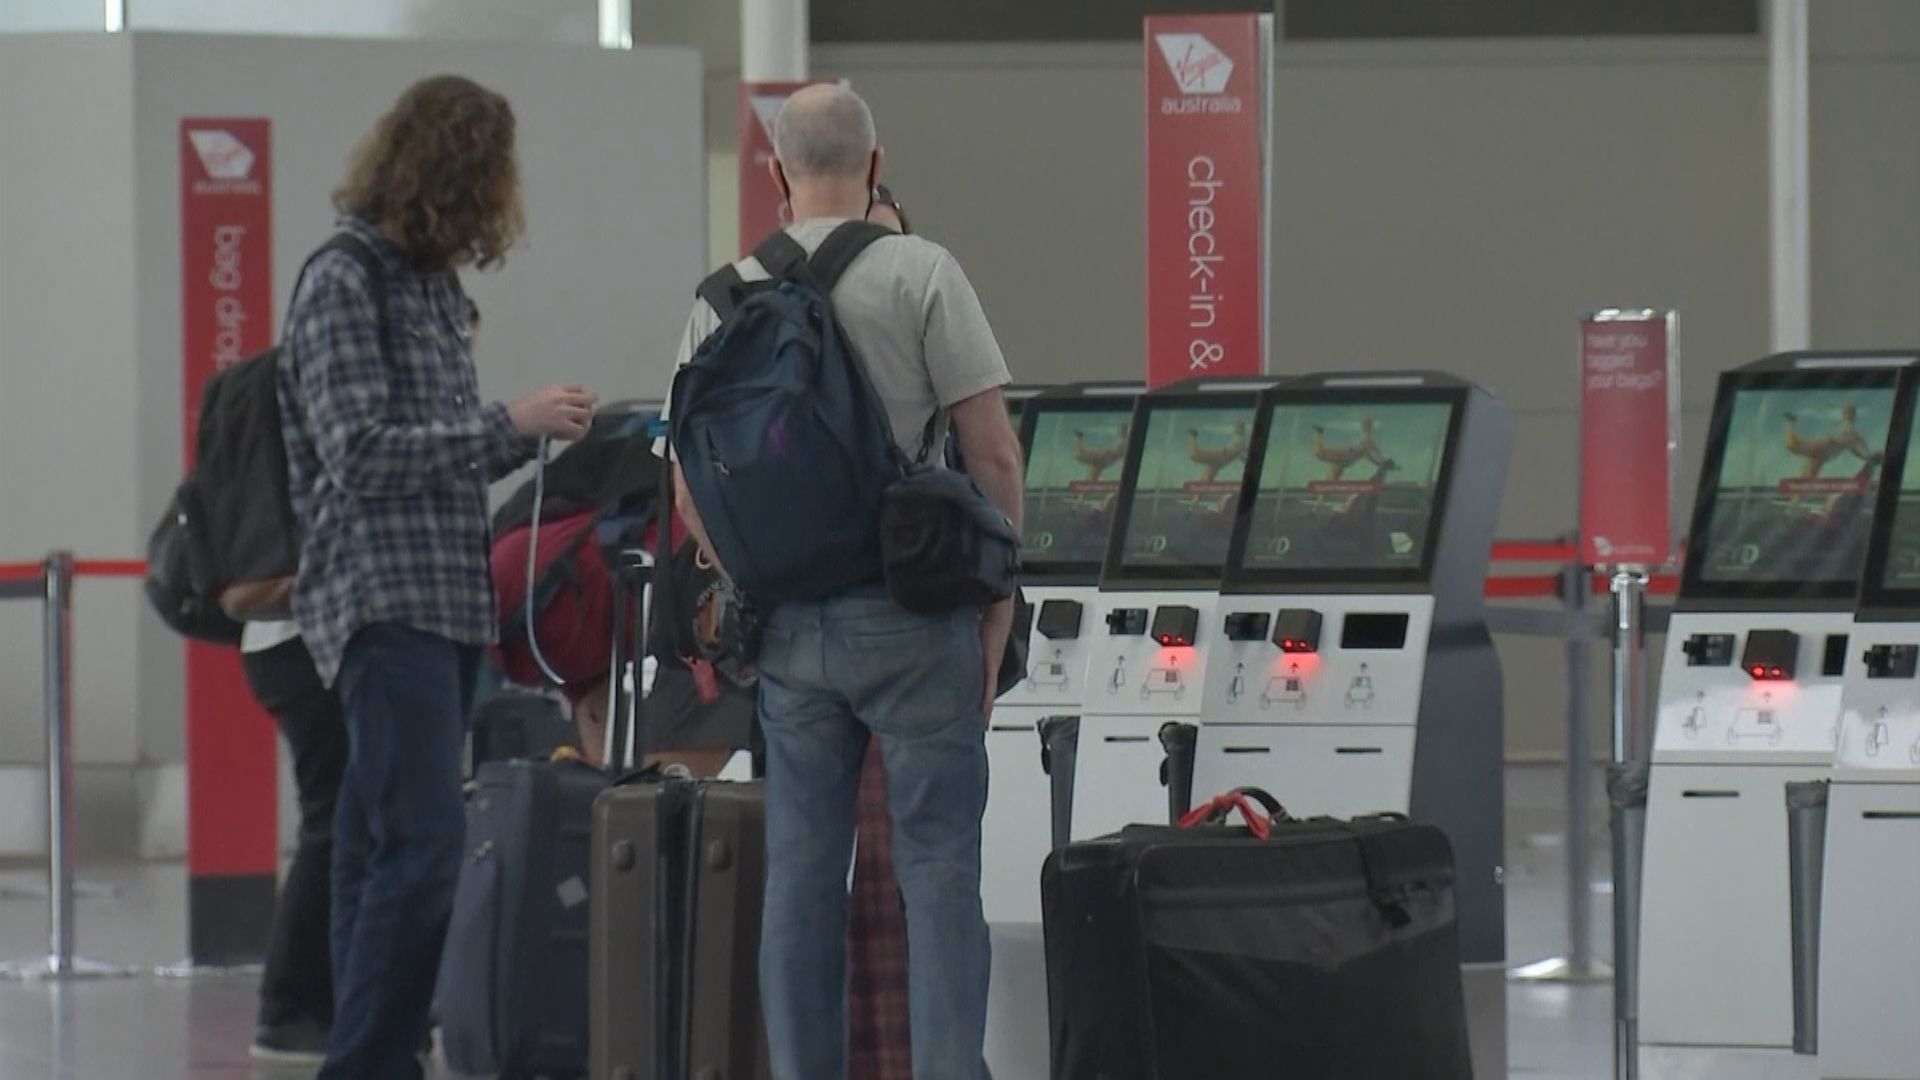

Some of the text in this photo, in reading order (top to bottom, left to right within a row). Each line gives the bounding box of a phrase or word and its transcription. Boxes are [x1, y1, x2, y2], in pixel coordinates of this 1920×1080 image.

[1161, 97, 1241, 114] australia
[209, 224, 248, 290] bag
[1188, 155, 1223, 369] check-in &
